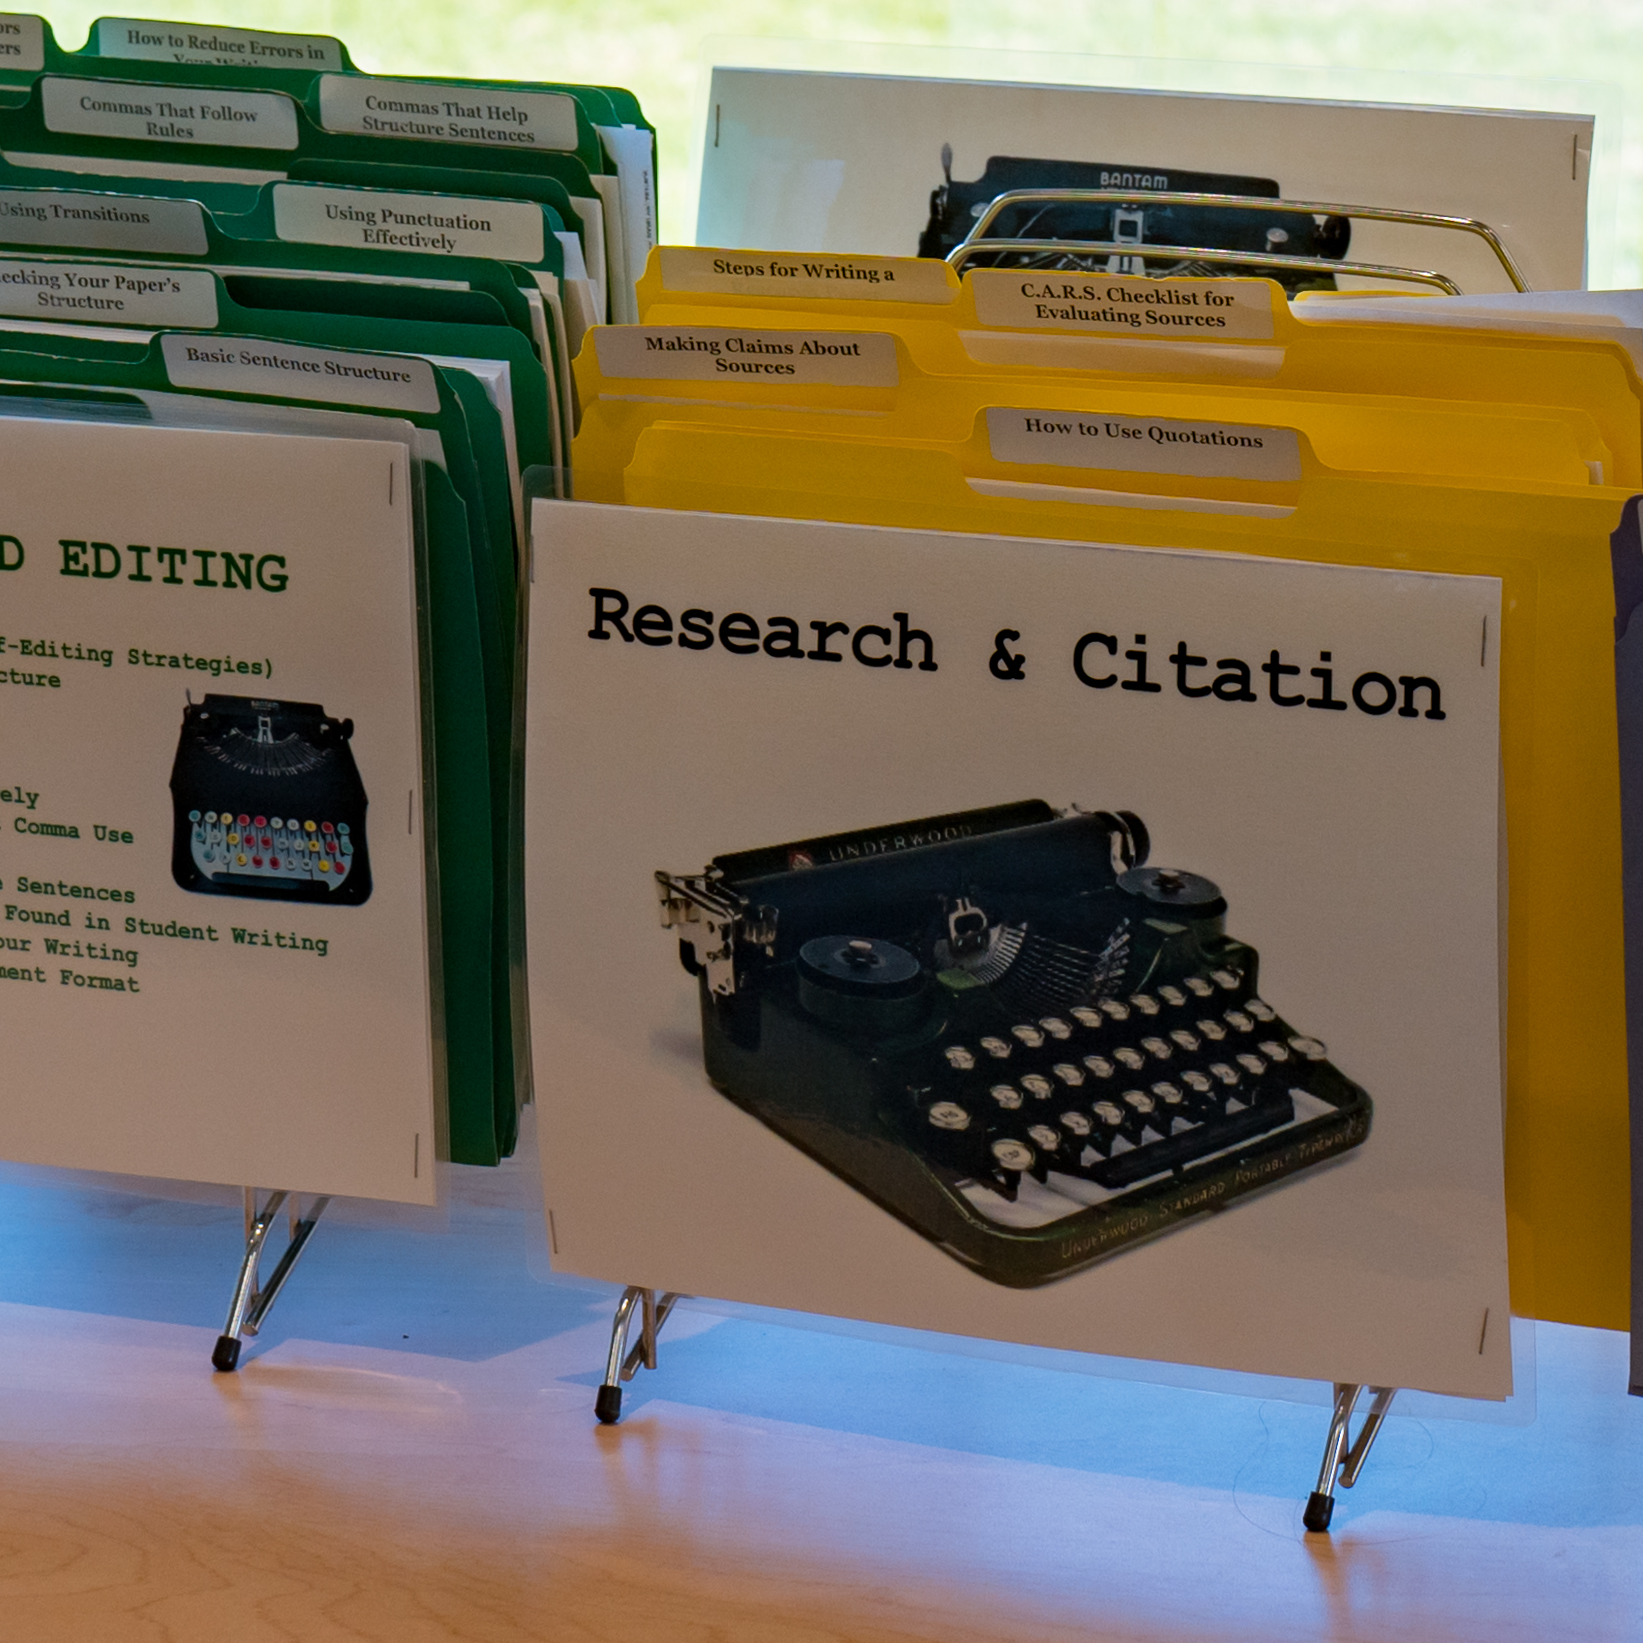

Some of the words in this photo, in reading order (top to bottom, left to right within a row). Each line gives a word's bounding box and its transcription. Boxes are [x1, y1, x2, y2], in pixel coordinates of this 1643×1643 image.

[366, 96, 439, 114] Commas
[442, 103, 482, 118] That
[487, 106, 528, 125] Help
[363, 116, 444, 136] Structure
[449, 123, 534, 143] Sentences
[1100, 171, 1168, 190] BANTAM
[326, 205, 377, 226] Using
[382, 209, 491, 231] Punctuation
[363, 229, 456, 253] Effectively
[64, 273, 109, 288] Your
[115, 276, 180, 294] Paper's
[714, 259, 764, 276] Steps
[770, 262, 798, 276] for
[801, 264, 879, 283] Writing
[884, 271, 894, 280] a
[38, 292, 124, 310] Structure
[1021, 284, 1101, 300] C.A.R.S.
[1107, 288, 1198, 305] Checklist
[1204, 291, 1234, 306] for
[1036, 305, 1141, 327] Evaluating
[1146, 310, 1225, 326] Sources
[645, 337, 721, 355] Making
[725, 338, 793, 354] Claims
[800, 341, 860, 355] About
[186, 348, 234, 363] Basic
[240, 352, 320, 373] Sentence
[324, 361, 411, 382] Structure
[716, 358, 795, 374] Sources
[1024, 418, 1072, 433] How
[1078, 421, 1099, 438] to
[1104, 423, 1142, 439] Use
[1148, 426, 1263, 447] Quotations
[59, 540, 288, 592] EDITING
[128, 649, 271, 679] Strategies)
[588, 588, 938, 671] Research
[989, 629, 1025, 680] &
[1073, 632, 1446, 720] Citation
[14, 817, 80, 838] Comma
[93, 825, 133, 843] Use
[5, 905, 71, 926] Found
[85, 912, 110, 930] in
[125, 917, 218, 941] Student
[231, 928, 328, 956] Writing
[60, 970, 140, 992] Format
